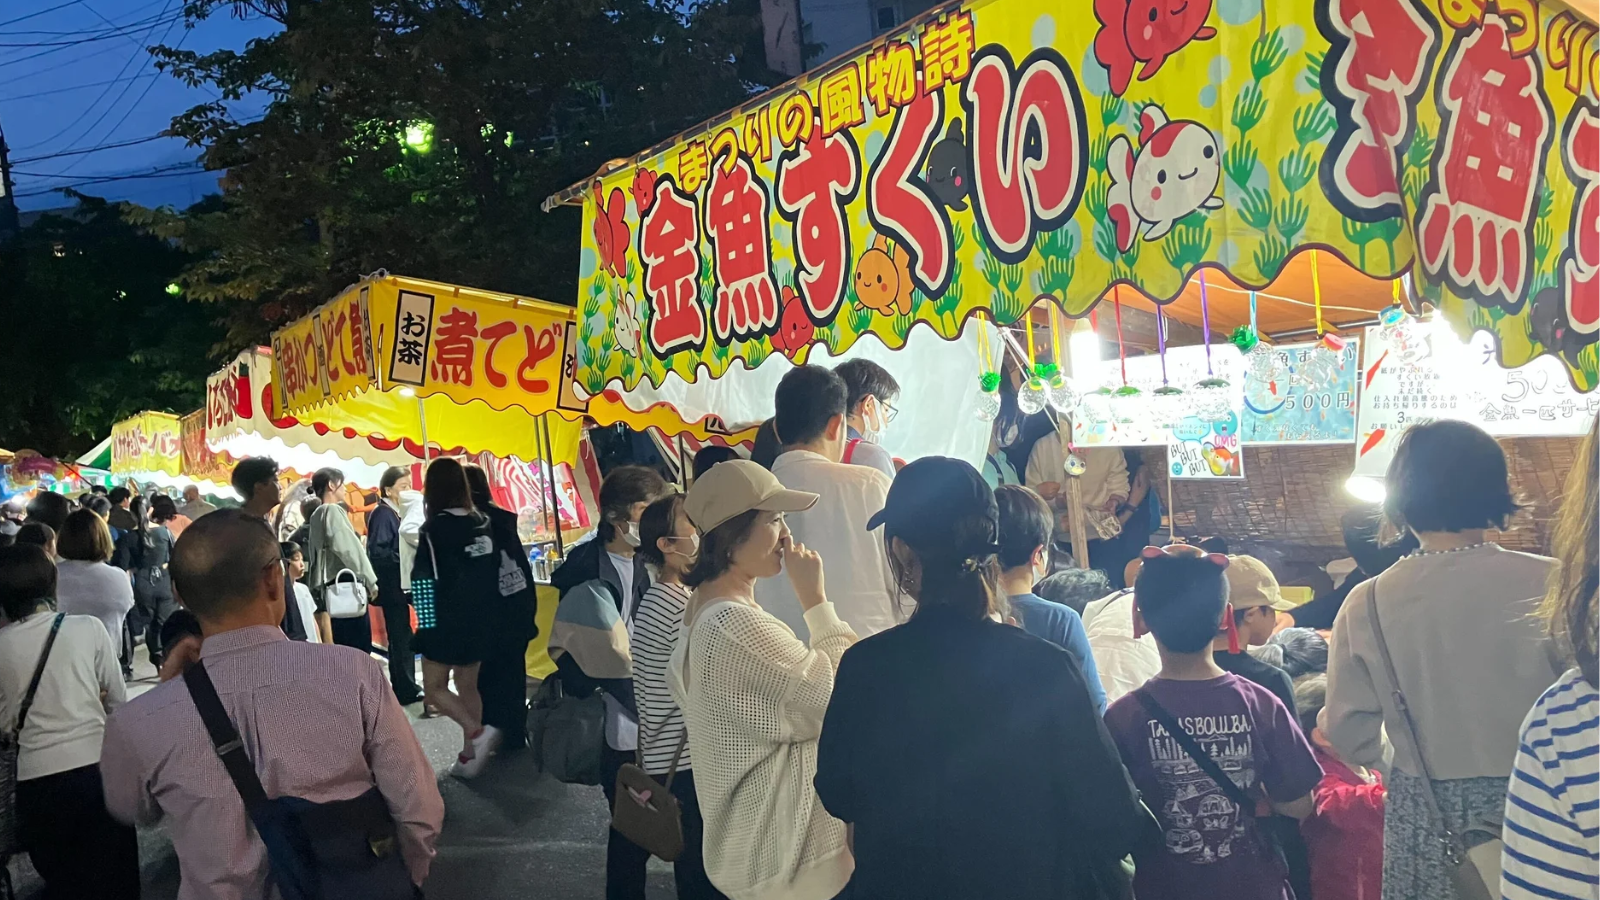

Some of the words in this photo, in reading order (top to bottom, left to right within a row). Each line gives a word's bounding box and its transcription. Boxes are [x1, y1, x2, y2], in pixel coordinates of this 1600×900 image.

[679, 8, 976, 194] まつりの風物詩
[640, 44, 1090, 358] 金魚すくい
[398, 311, 425, 366] お茶
[281, 333, 319, 401] 串かつ
[1285, 391, 1350, 410] 500円
[1170, 439, 1188, 458] BUT
[1214, 433, 1238, 449] OMG
[1180, 447, 1198, 466] BUT
[1189, 458, 1207, 476] BUT
